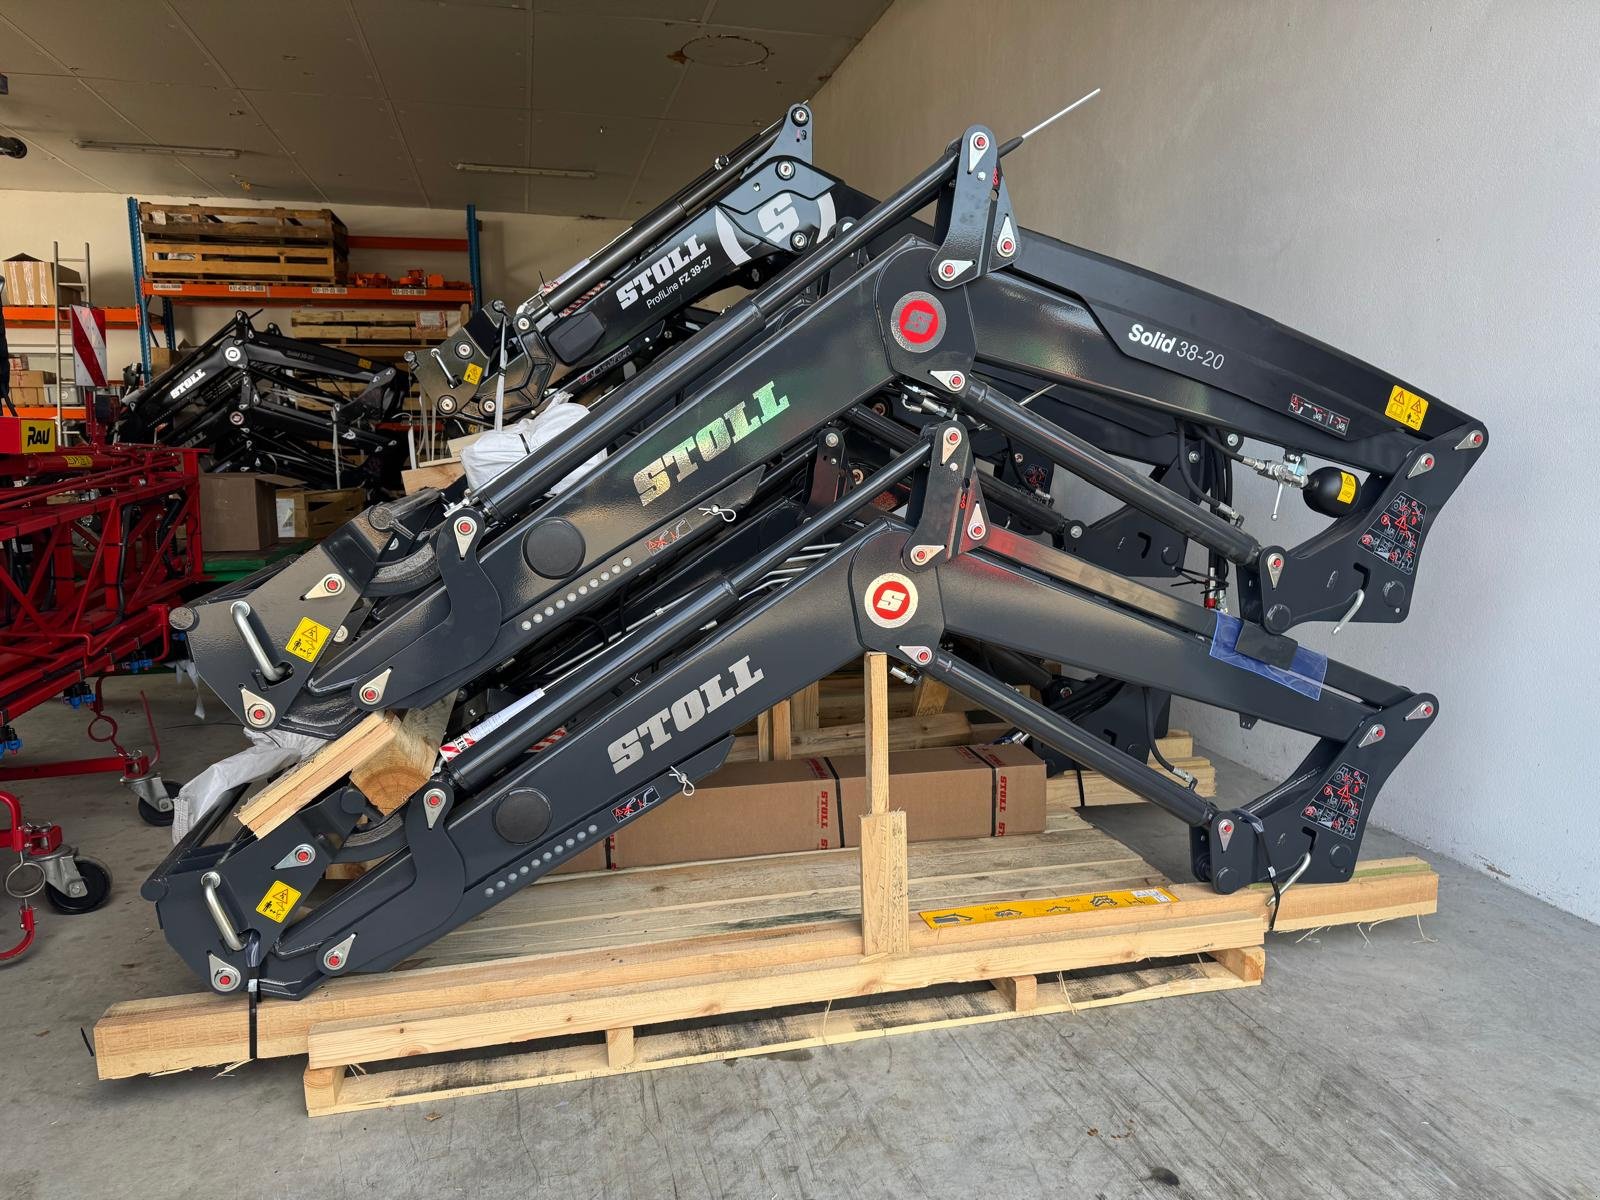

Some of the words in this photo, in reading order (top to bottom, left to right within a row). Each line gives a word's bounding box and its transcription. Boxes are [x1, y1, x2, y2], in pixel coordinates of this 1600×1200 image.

[616, 234, 707, 310] STOLL
[646, 283, 679, 309] ProfiLine
[678, 272, 691, 286] FZ
[690, 255, 712, 277] 39-27
[1128, 323, 1177, 354] Solid
[1176, 341, 1225, 370] 38-20
[169, 368, 207, 400] STOLL
[27, 426, 50, 447] RAU
[633, 380, 790, 507] STOLL
[607, 655, 765, 775] STOLL
[820, 790, 829, 829] STOLL
[999, 775, 1008, 813] STOLL
